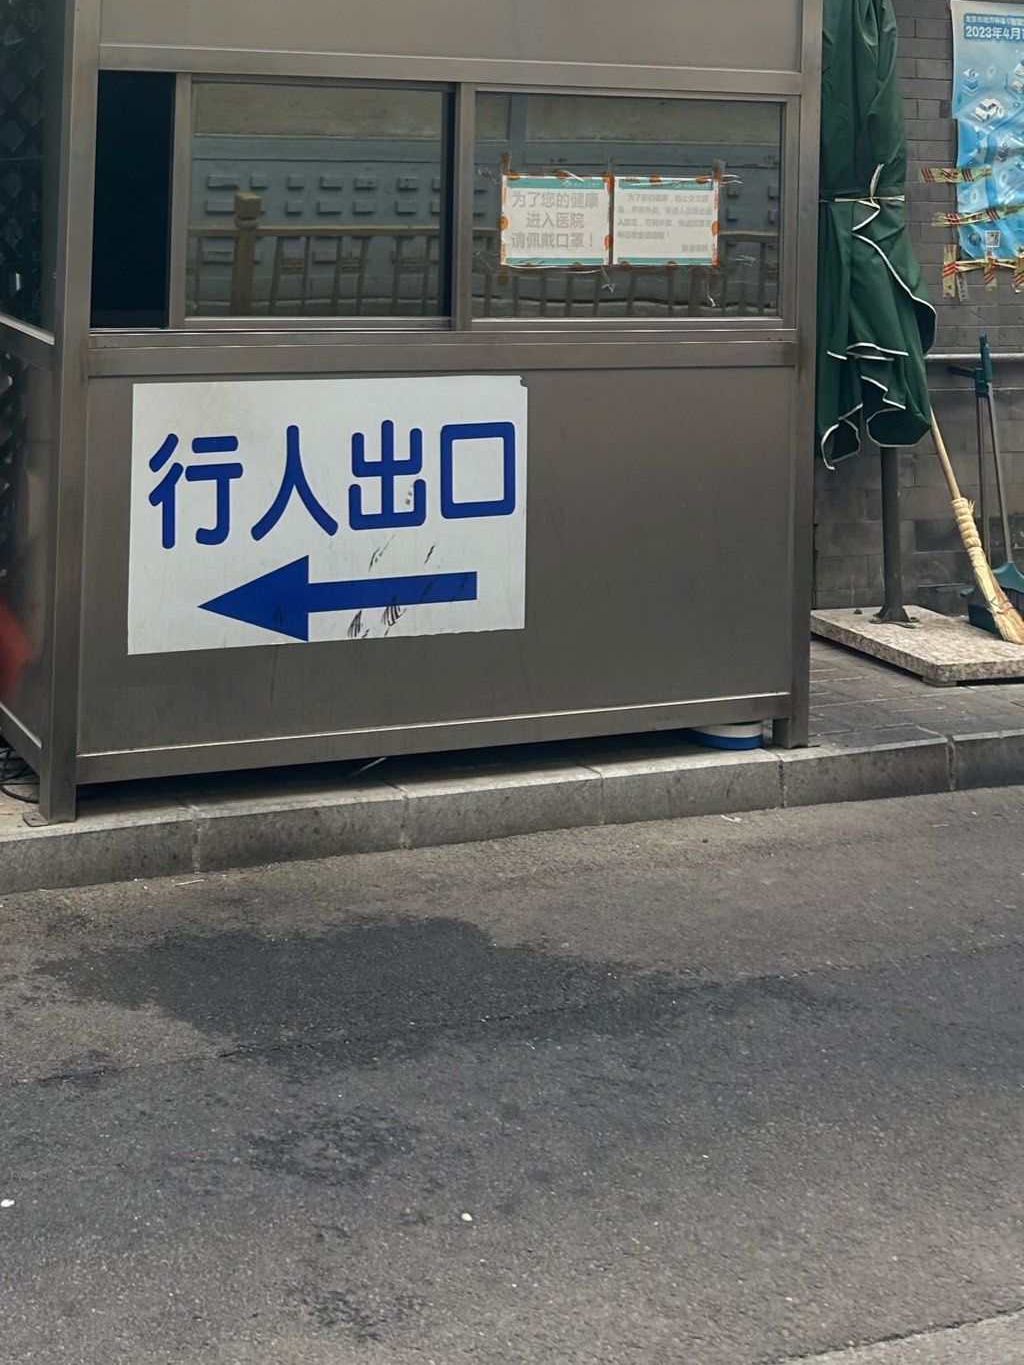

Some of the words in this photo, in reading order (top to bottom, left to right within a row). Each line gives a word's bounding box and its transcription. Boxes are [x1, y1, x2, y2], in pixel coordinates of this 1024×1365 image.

[512, 191, 599, 209] 为了您的健康
[526, 212, 585, 229] 进入医院
[149, 420, 516, 549] 行人出口
